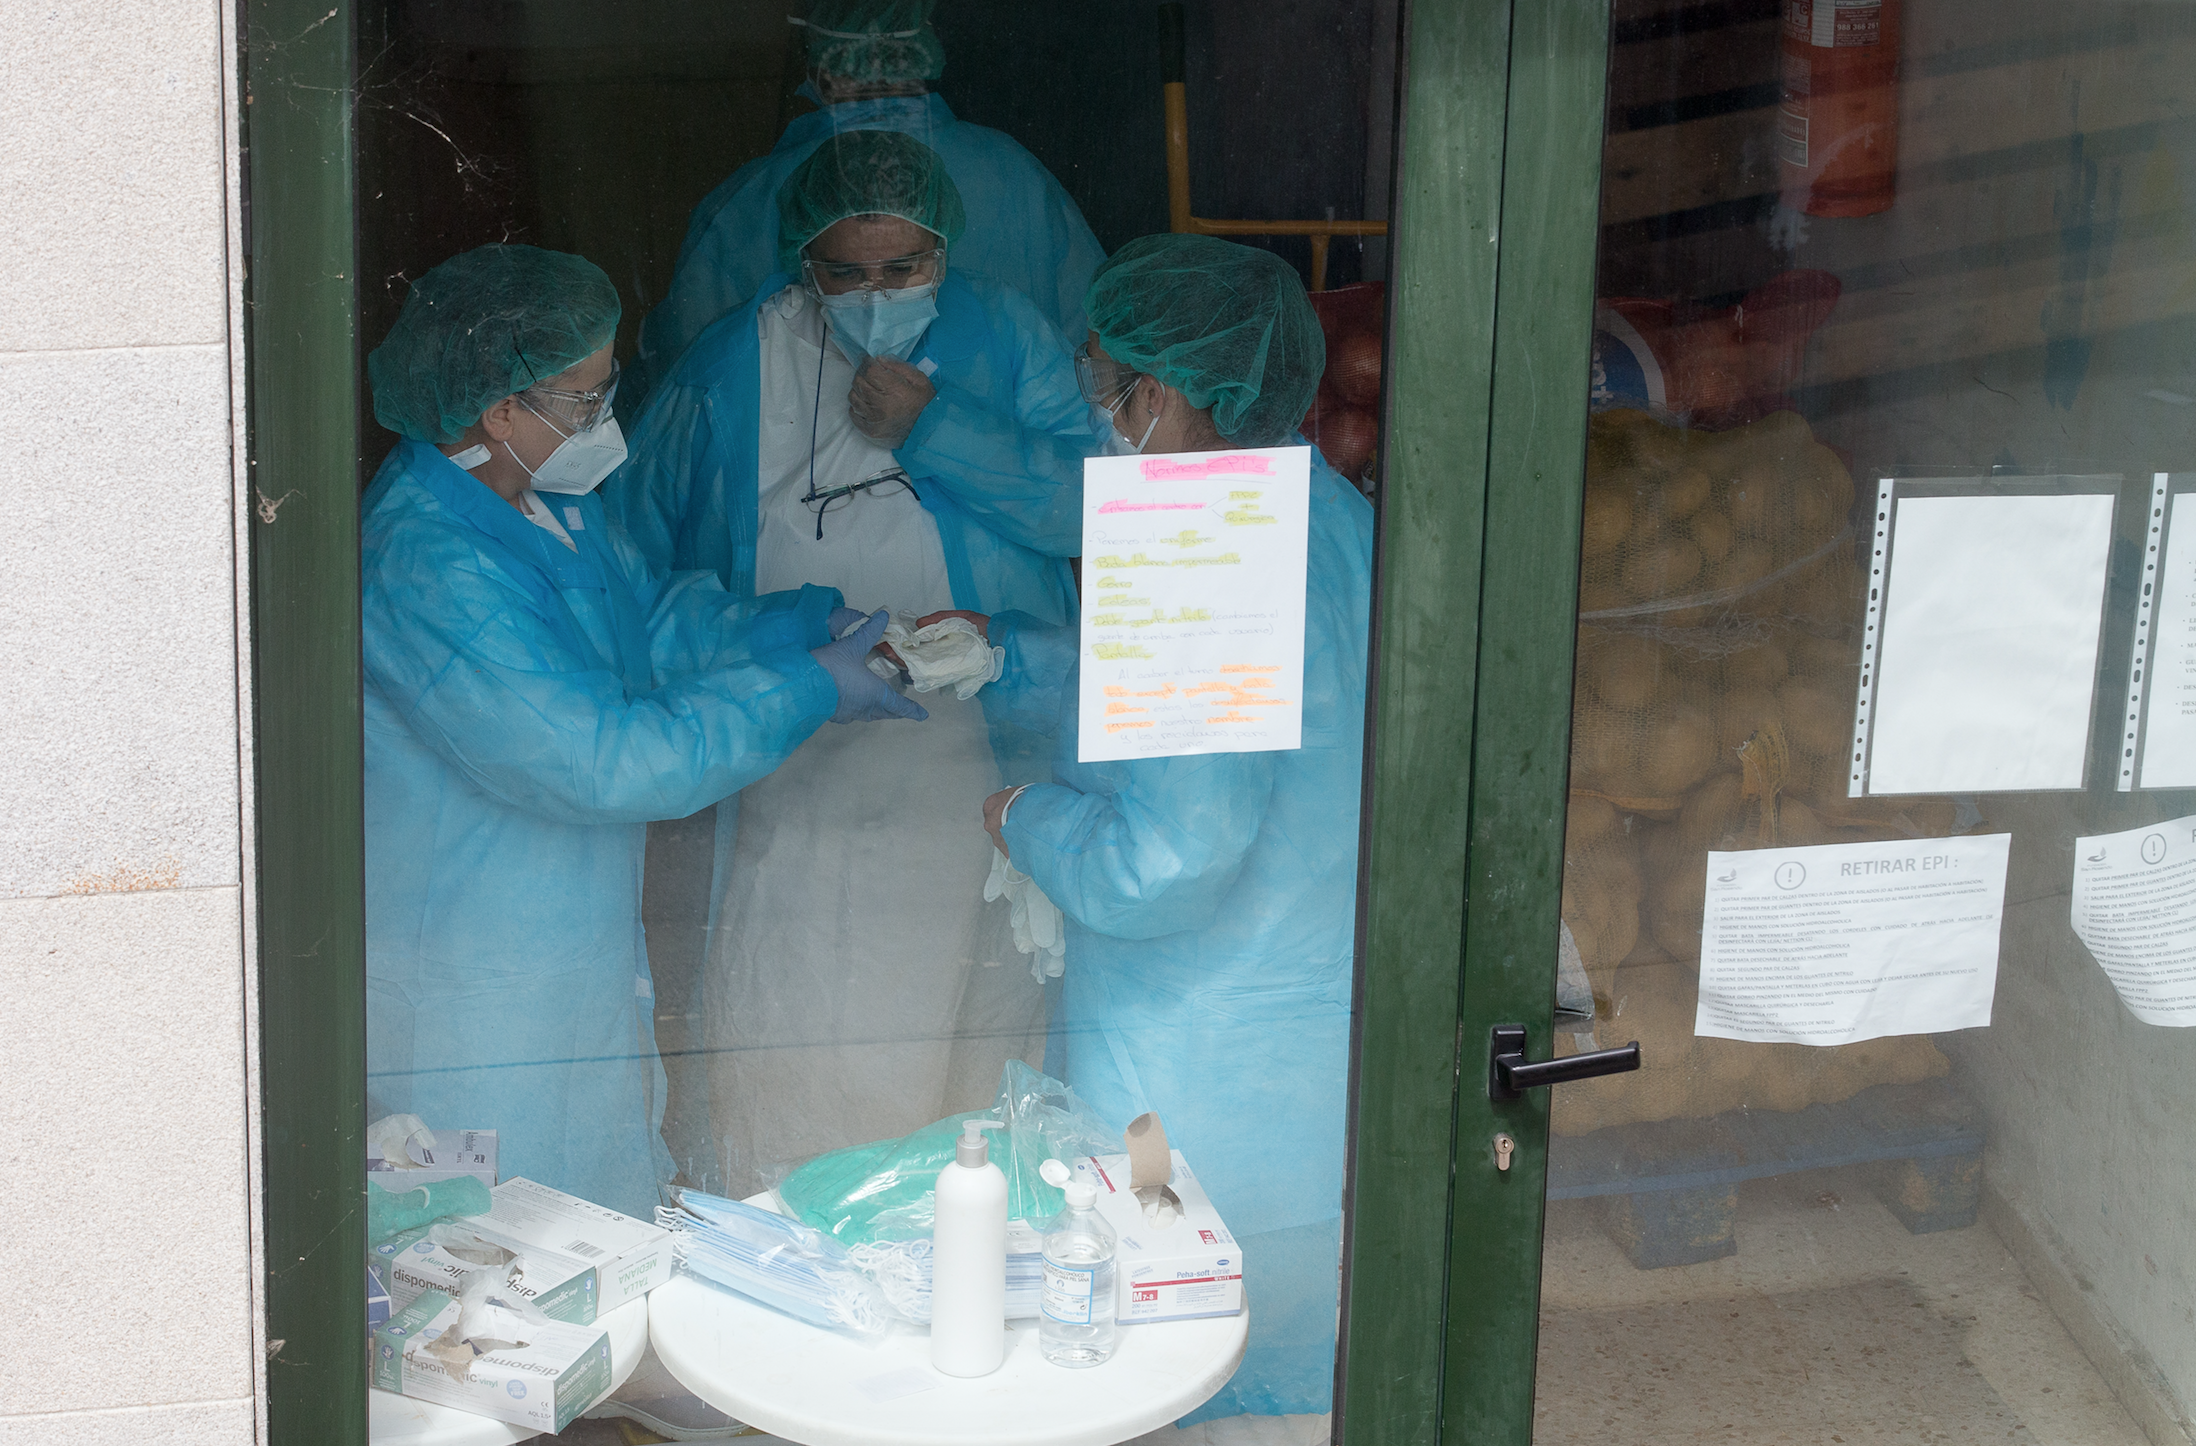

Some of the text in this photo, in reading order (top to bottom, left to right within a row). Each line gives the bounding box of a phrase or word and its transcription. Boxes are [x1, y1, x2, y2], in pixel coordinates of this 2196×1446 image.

[1840, 858, 1916, 877] RETIRAR
[1922, 855, 1948, 871] EPI
[618, 1258, 658, 1284] MEDIANA
[1177, 1270, 1210, 1278] Peha-soft
[624, 1276, 648, 1295] TALLA
[1133, 1292, 1142, 1302] M
[384, 1361, 391, 1371] L
[478, 1378, 498, 1388] vinyl
